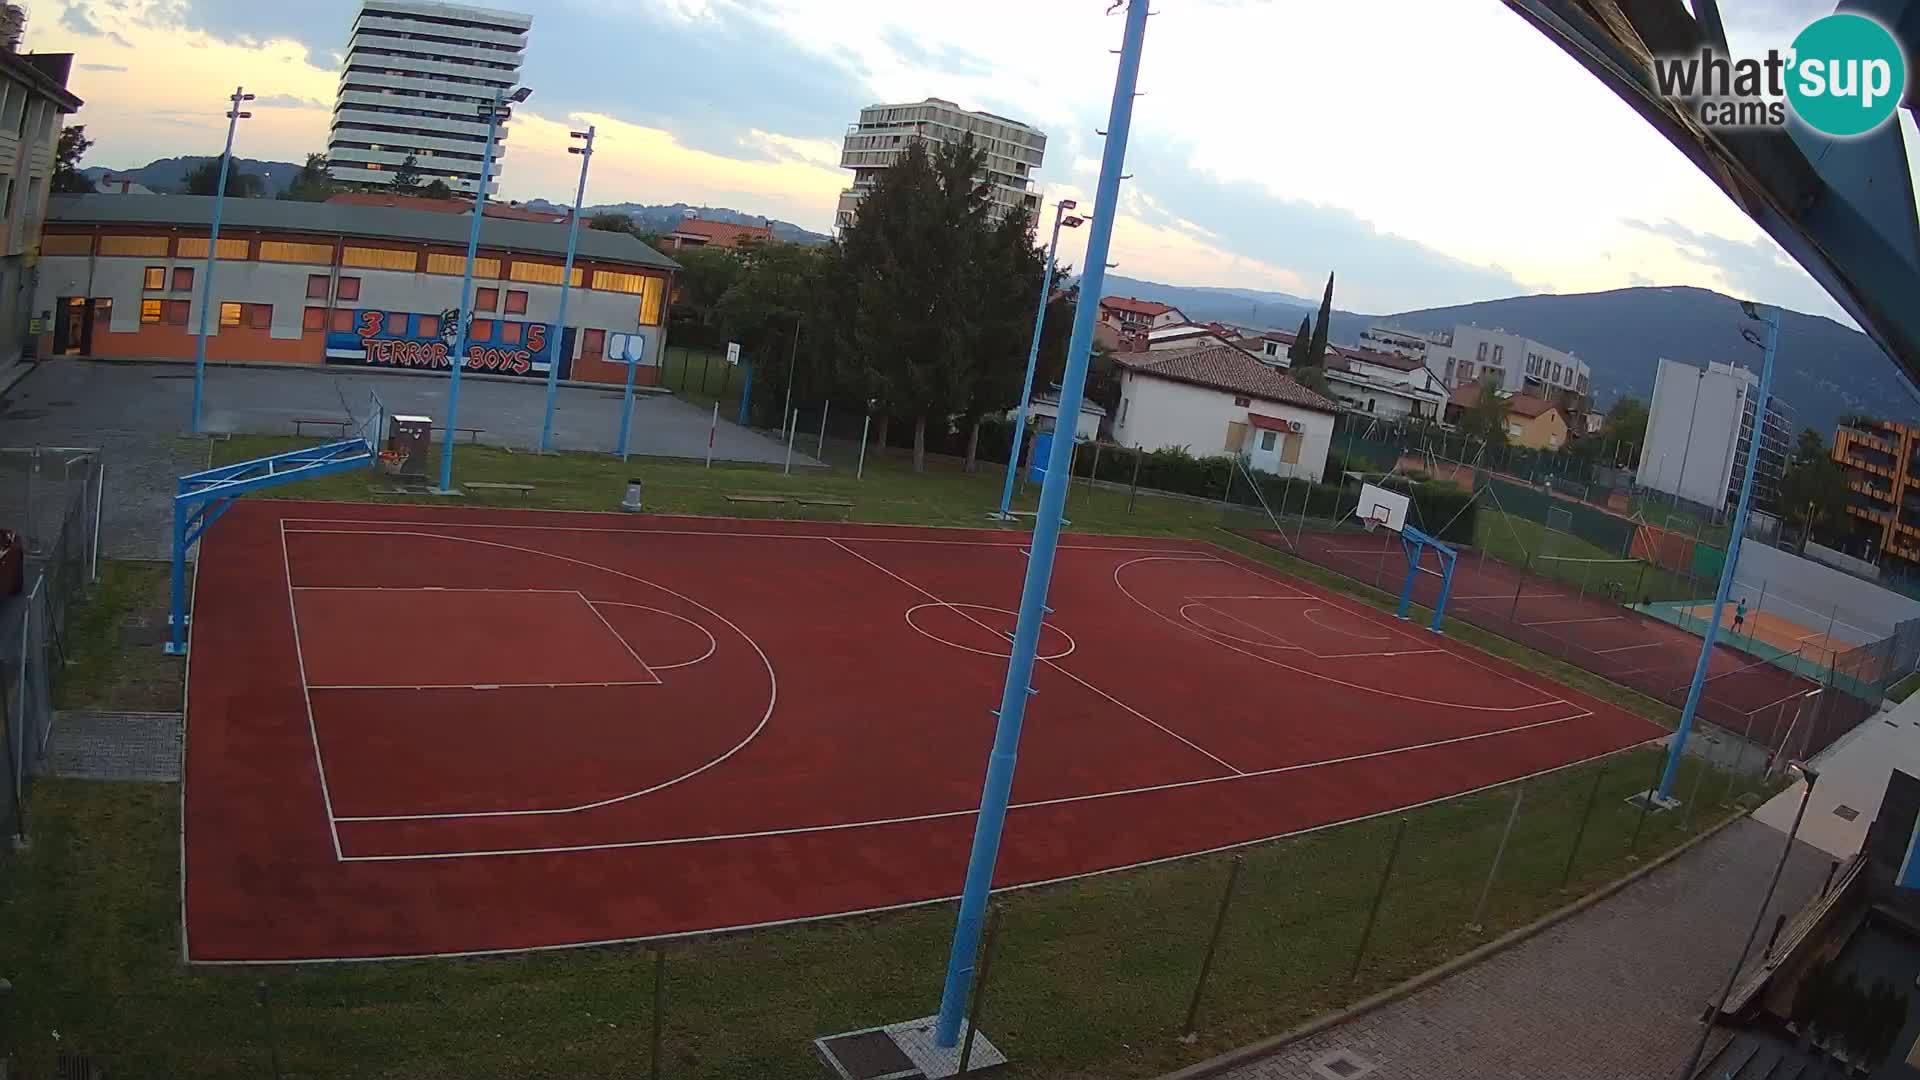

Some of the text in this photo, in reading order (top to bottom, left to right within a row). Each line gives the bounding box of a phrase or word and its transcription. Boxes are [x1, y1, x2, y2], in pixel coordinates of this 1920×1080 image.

[358, 312, 547, 351] 3 5
[363, 339, 530, 374] TERROR BOYS
